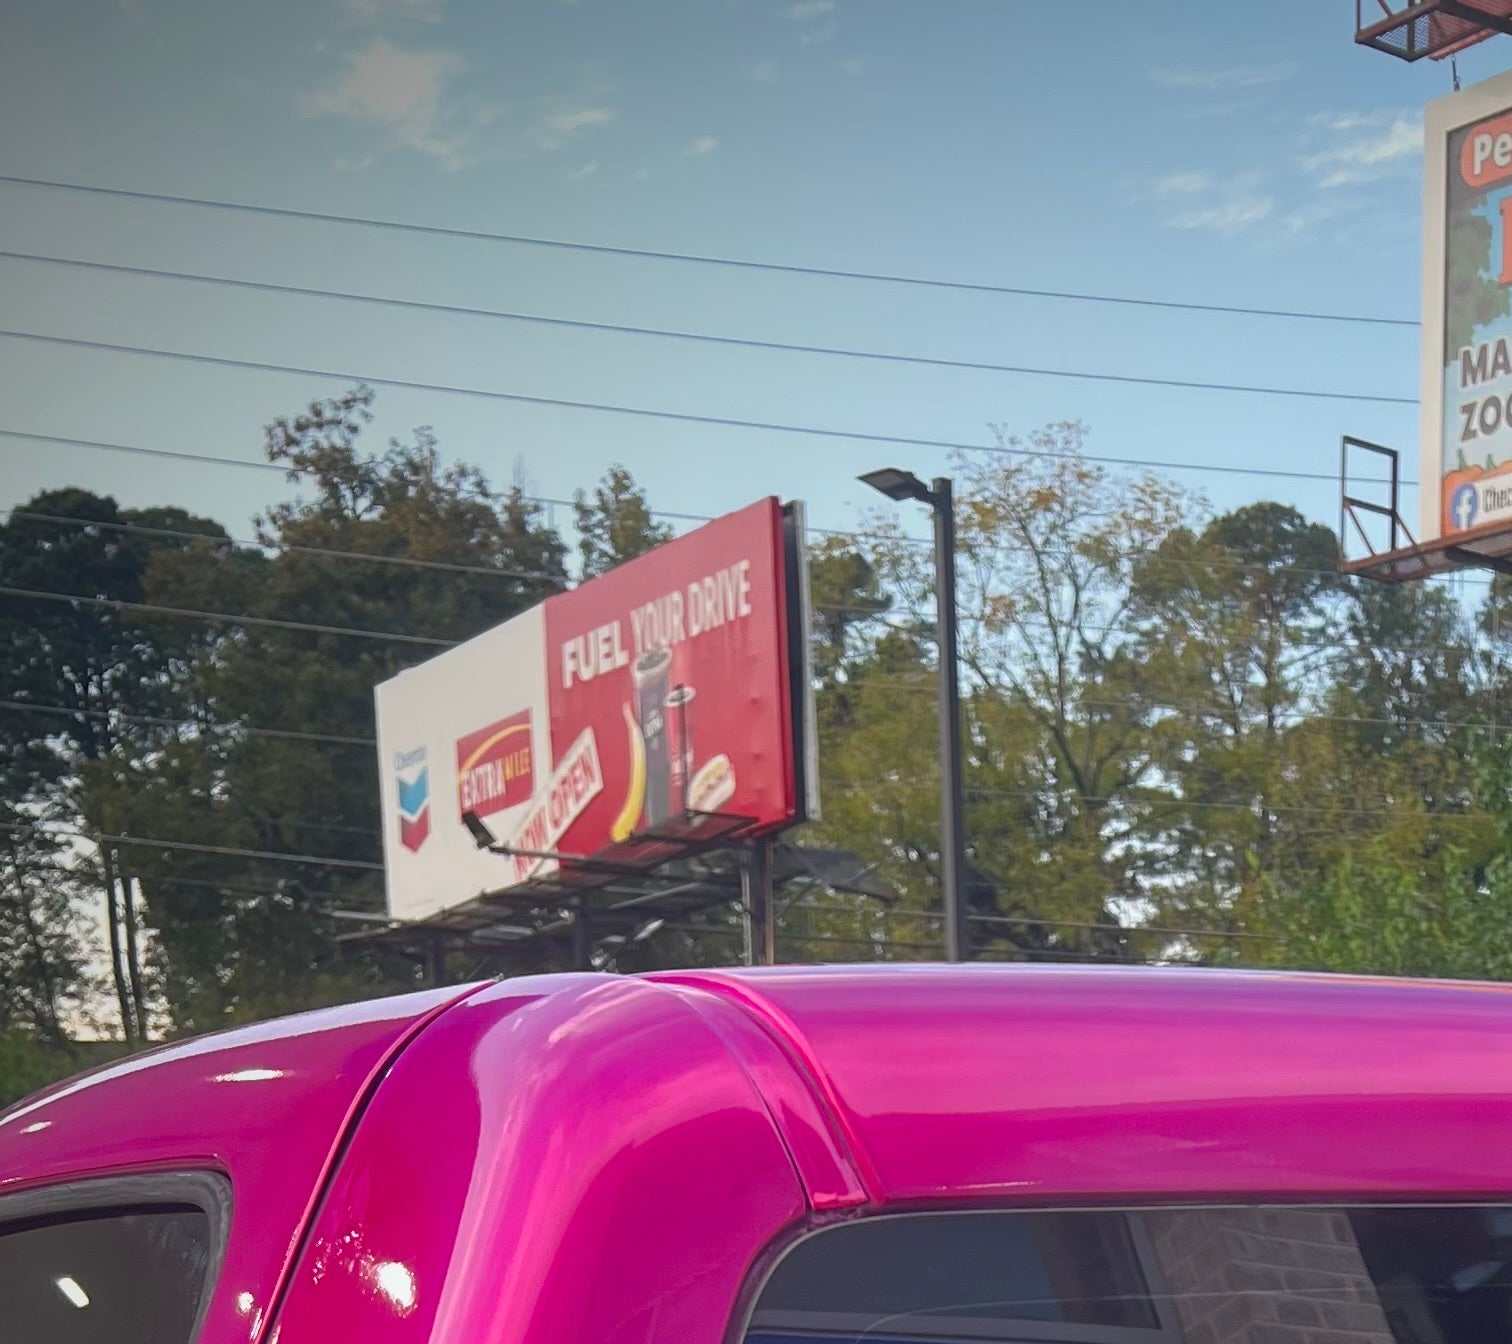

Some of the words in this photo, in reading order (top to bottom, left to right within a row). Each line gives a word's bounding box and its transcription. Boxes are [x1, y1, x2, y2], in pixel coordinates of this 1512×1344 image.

[562, 620, 629, 689] FUEL
[631, 591, 685, 652] YOUR
[687, 560, 752, 637] DRIVE
